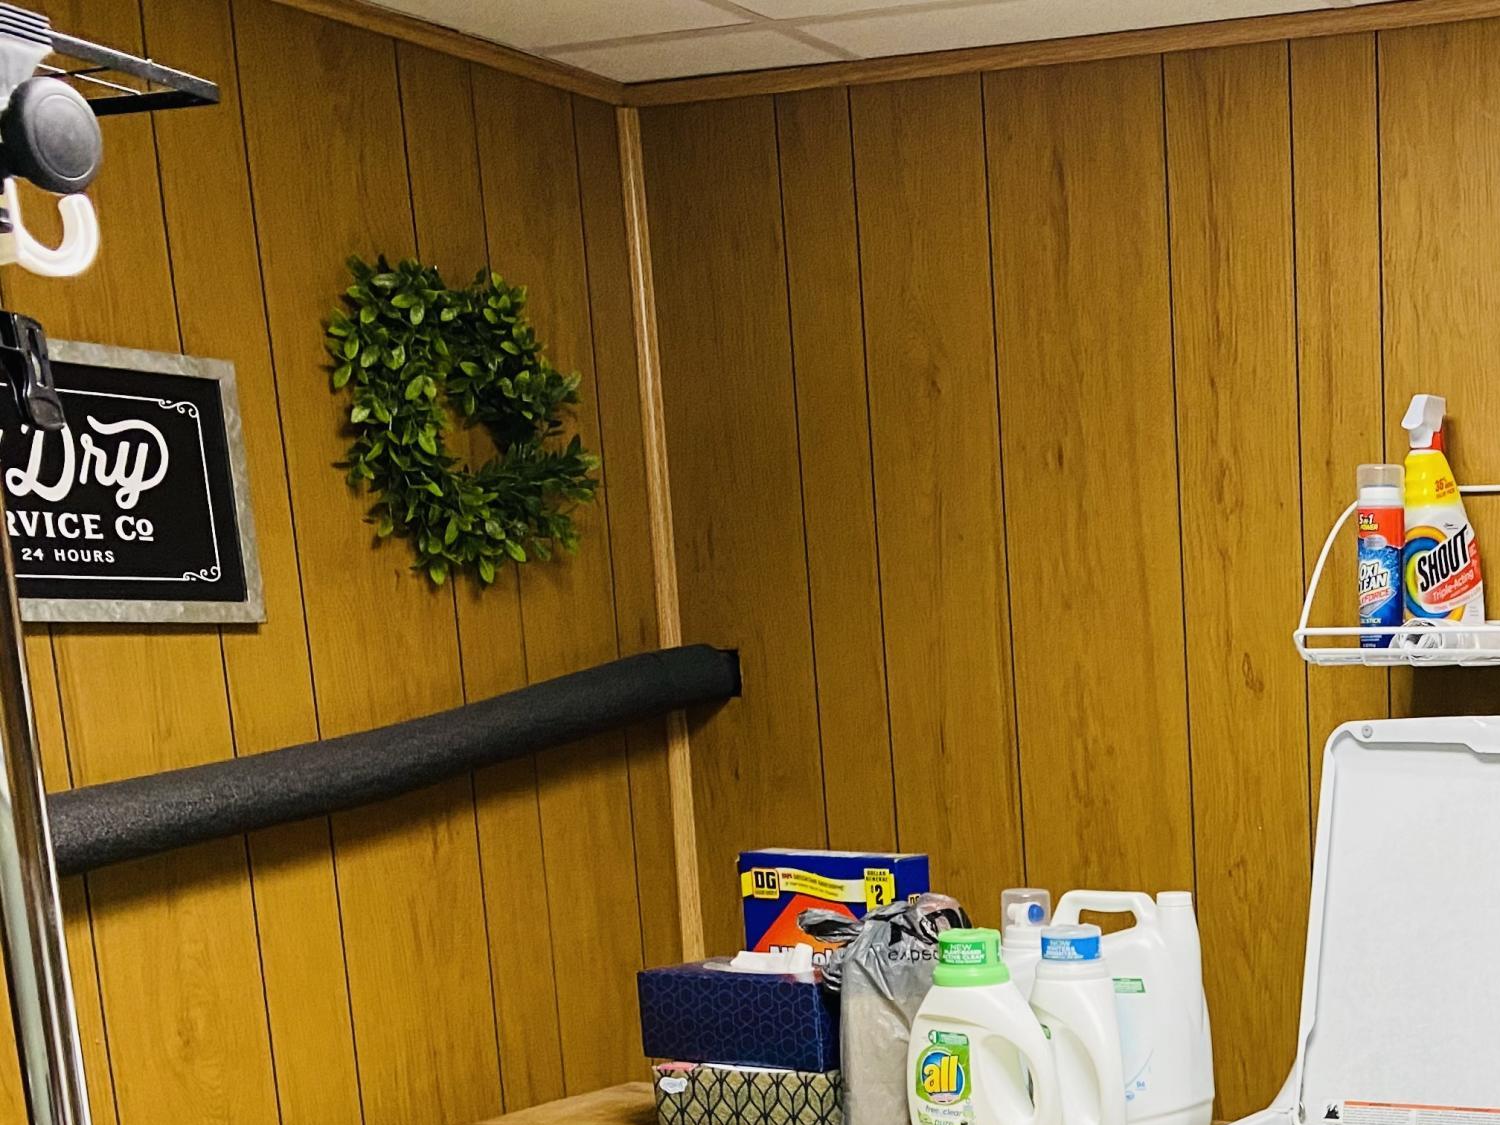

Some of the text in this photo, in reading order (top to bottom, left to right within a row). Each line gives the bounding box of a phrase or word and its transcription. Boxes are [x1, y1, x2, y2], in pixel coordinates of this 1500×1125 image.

[6, 415, 169, 509] Dry
[6, 510, 154, 541] RVICE Co
[21, 548, 115, 563] 24 HOURS
[1416, 524, 1468, 592] SHOUT
[1360, 562, 1379, 580] OXI
[1359, 572, 1388, 594] LEAN
[754, 871, 777, 889] DG
[951, 943, 972, 951] NEW
[923, 1054, 959, 1094] all
